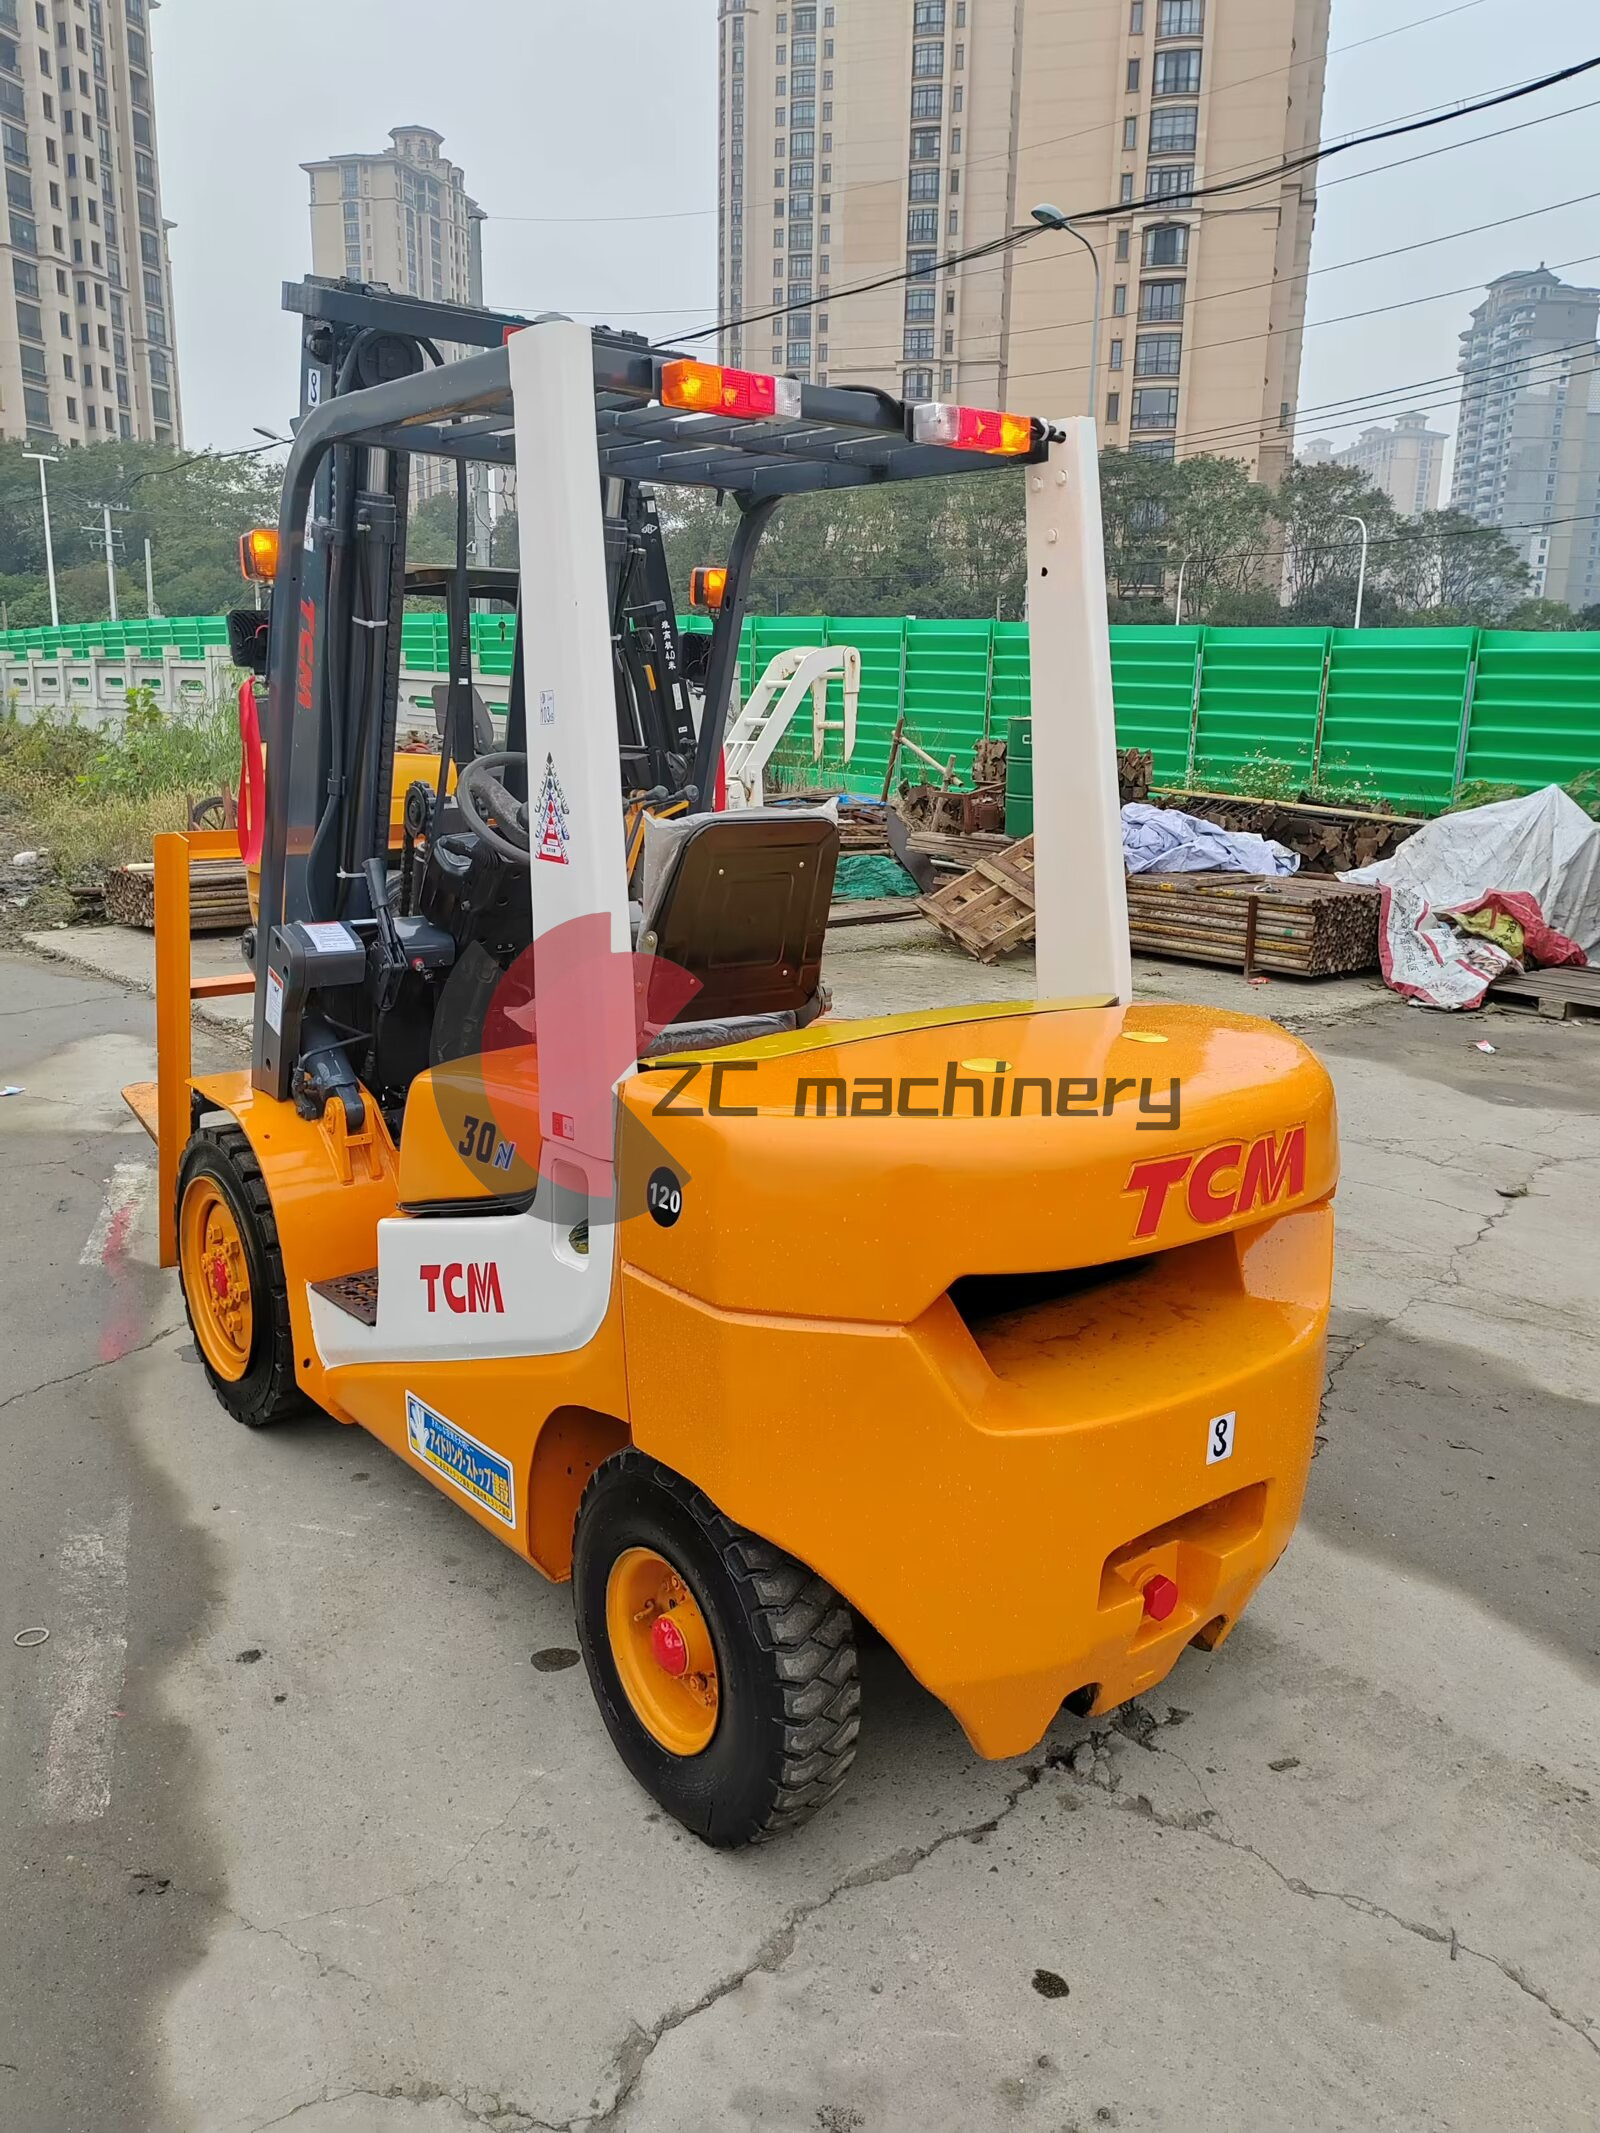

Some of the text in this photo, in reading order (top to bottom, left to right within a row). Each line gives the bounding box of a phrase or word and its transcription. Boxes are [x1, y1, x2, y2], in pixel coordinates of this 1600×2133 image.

[299, 598, 316, 709] TCM
[650, 1182, 681, 1213] 120
[1126, 1126, 1305, 1238] TCM
[420, 1262, 505, 1313] TCM
